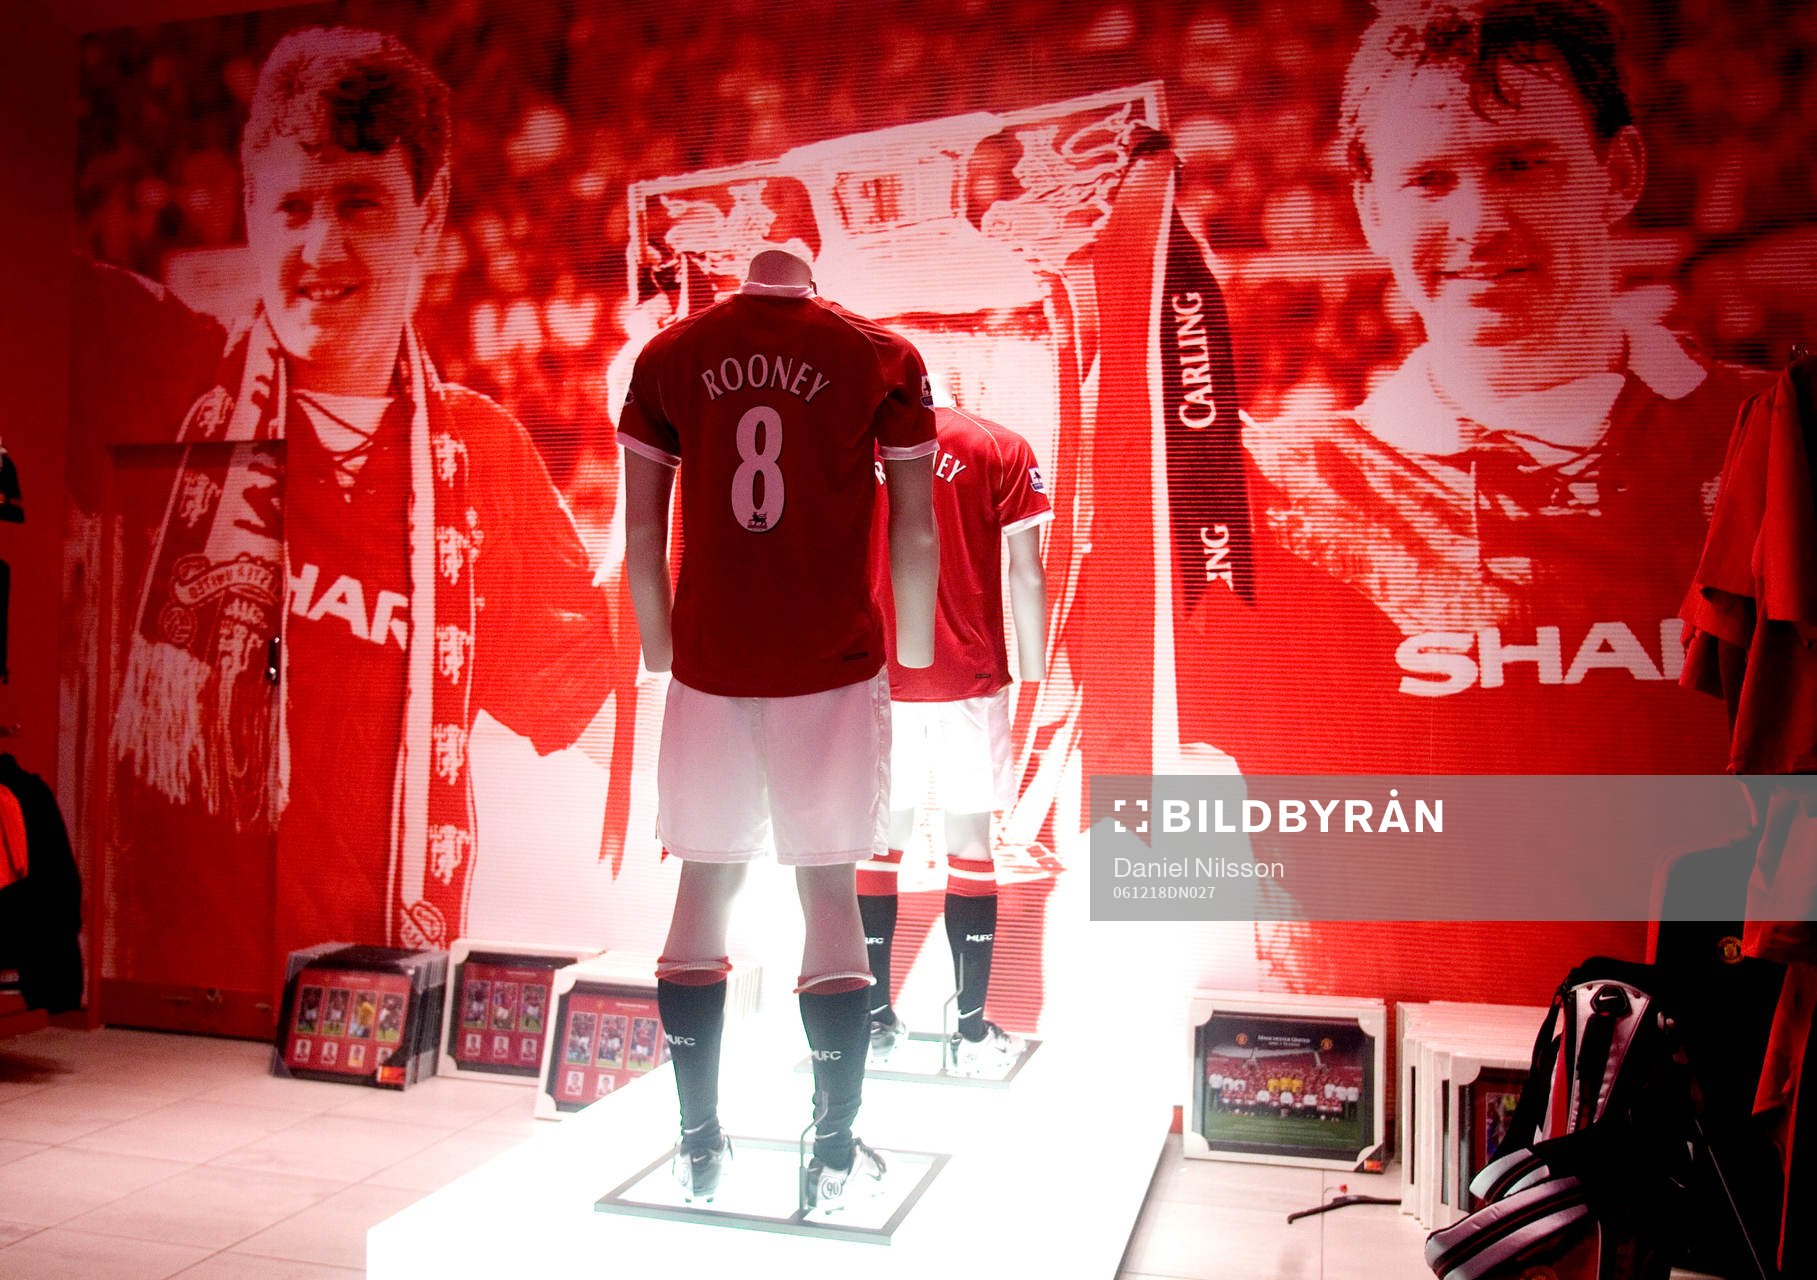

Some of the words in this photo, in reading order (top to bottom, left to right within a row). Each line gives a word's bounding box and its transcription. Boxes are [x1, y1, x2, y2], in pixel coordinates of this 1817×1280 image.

[701, 354, 831, 402] ROONEY
[1172, 292, 1217, 429] CARLING
[731, 406, 785, 532] 8
[966, 934, 993, 942] MUFC
